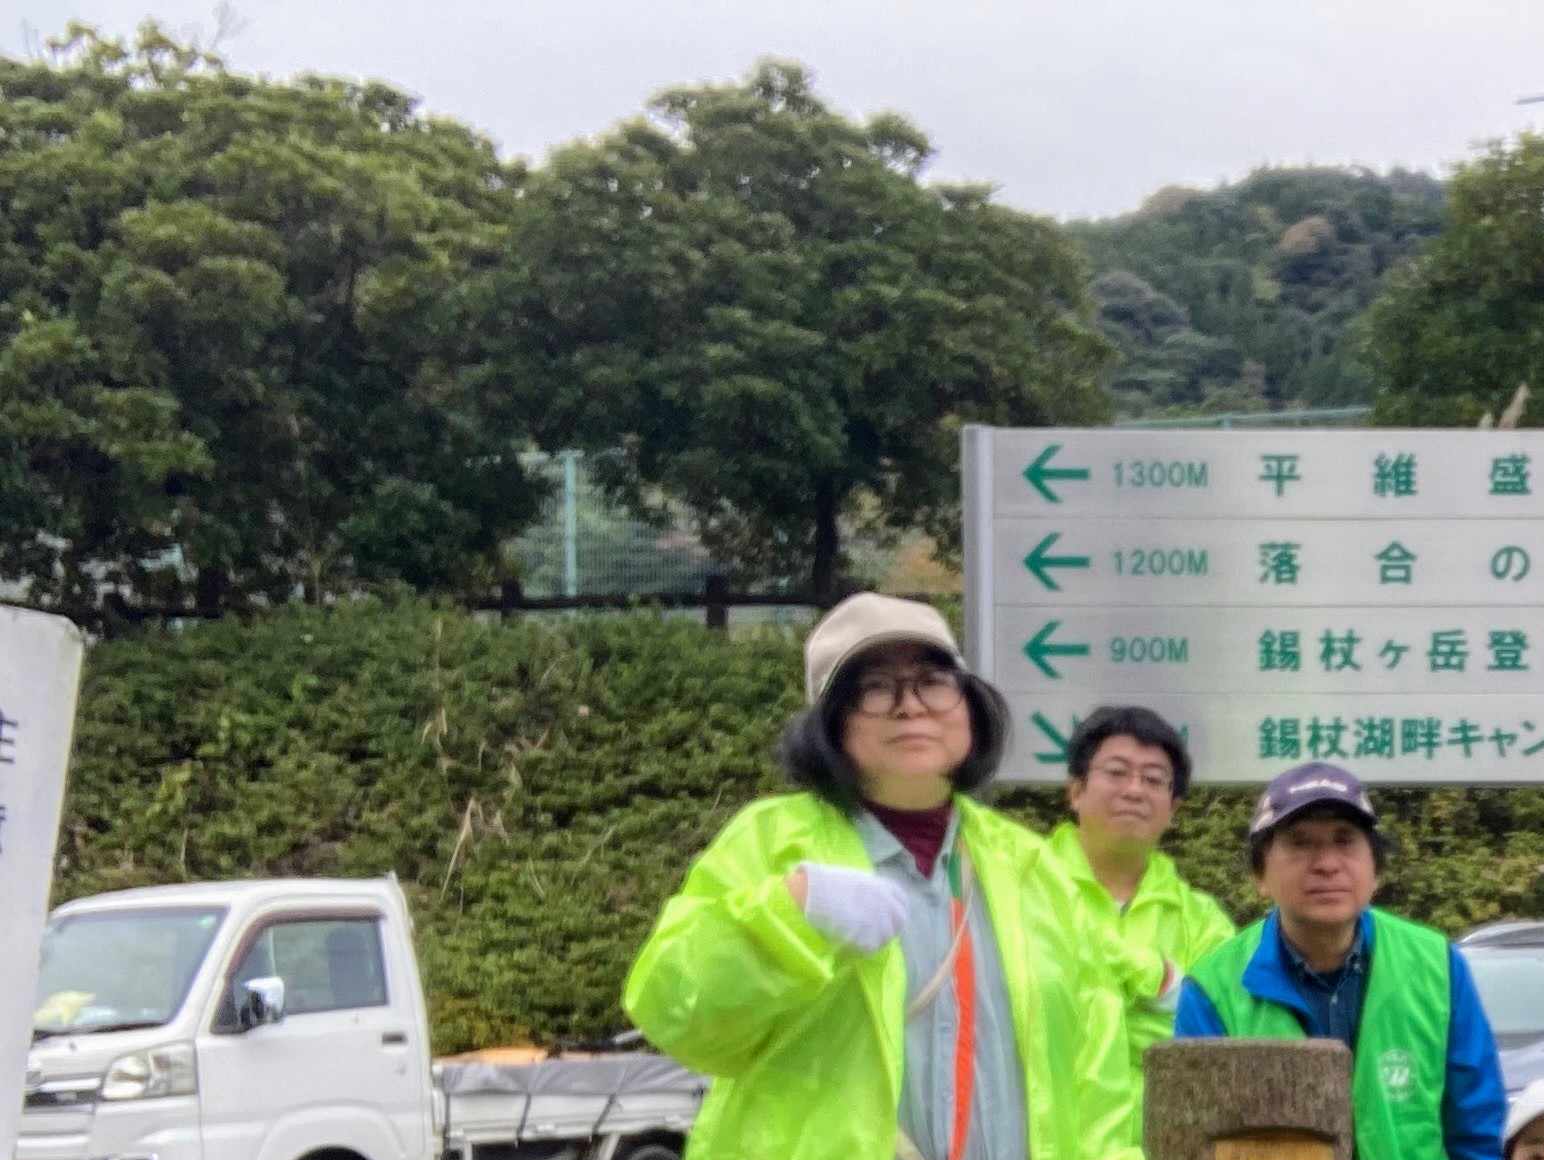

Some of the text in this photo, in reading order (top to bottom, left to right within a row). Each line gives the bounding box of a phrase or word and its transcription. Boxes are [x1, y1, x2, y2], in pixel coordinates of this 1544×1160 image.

[1112, 462, 1209, 488] 1300M
[1112, 550, 1209, 576] 1200M
[1109, 637, 1189, 663] 900M
